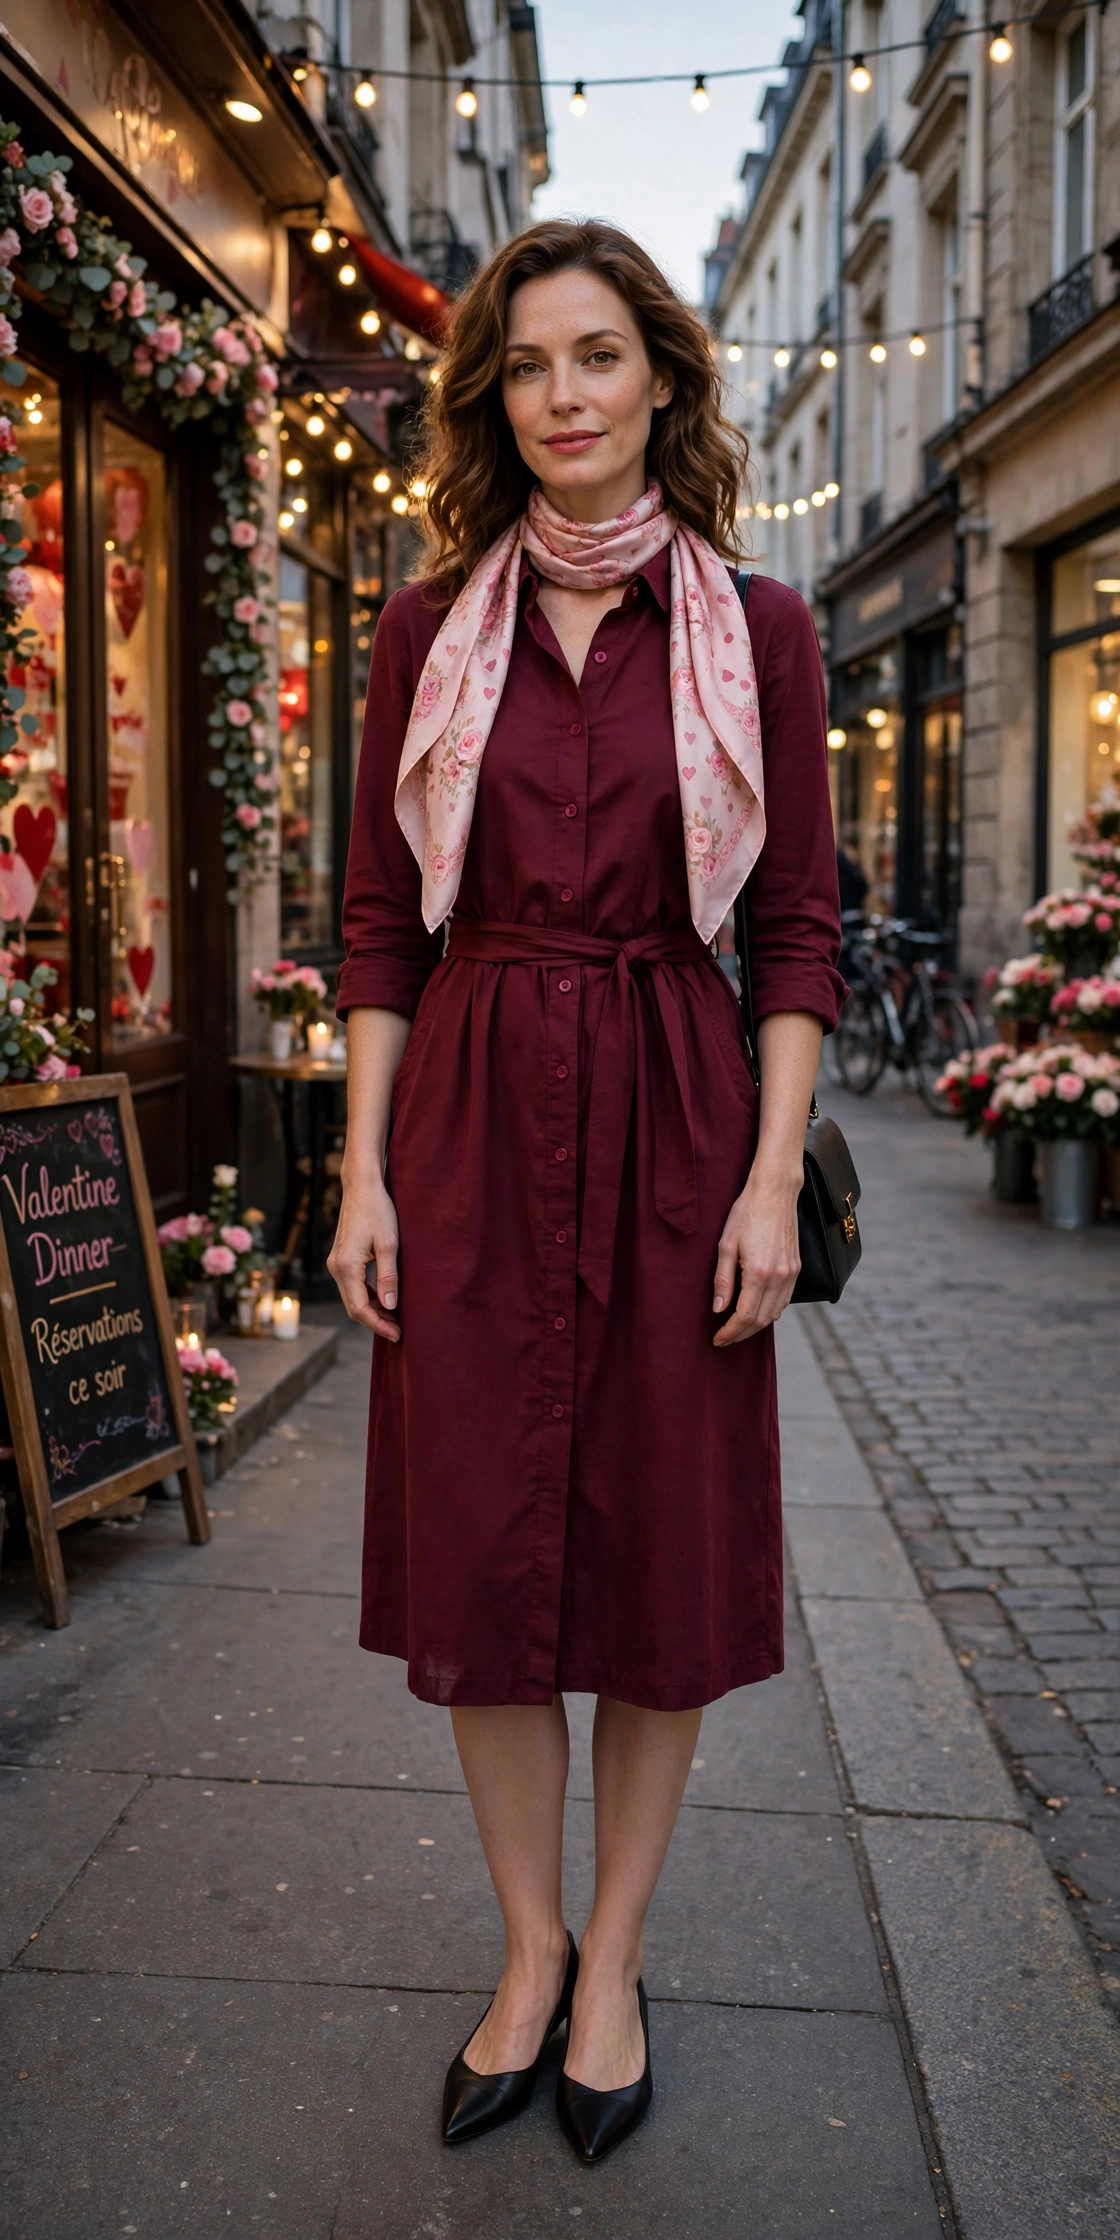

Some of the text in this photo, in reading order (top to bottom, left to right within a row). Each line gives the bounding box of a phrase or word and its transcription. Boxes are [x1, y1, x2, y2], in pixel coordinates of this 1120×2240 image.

[2, 1162, 120, 1224] Valentine
[31, 1305, 143, 1364] Réservations
[69, 1360, 126, 1405] ce soir
